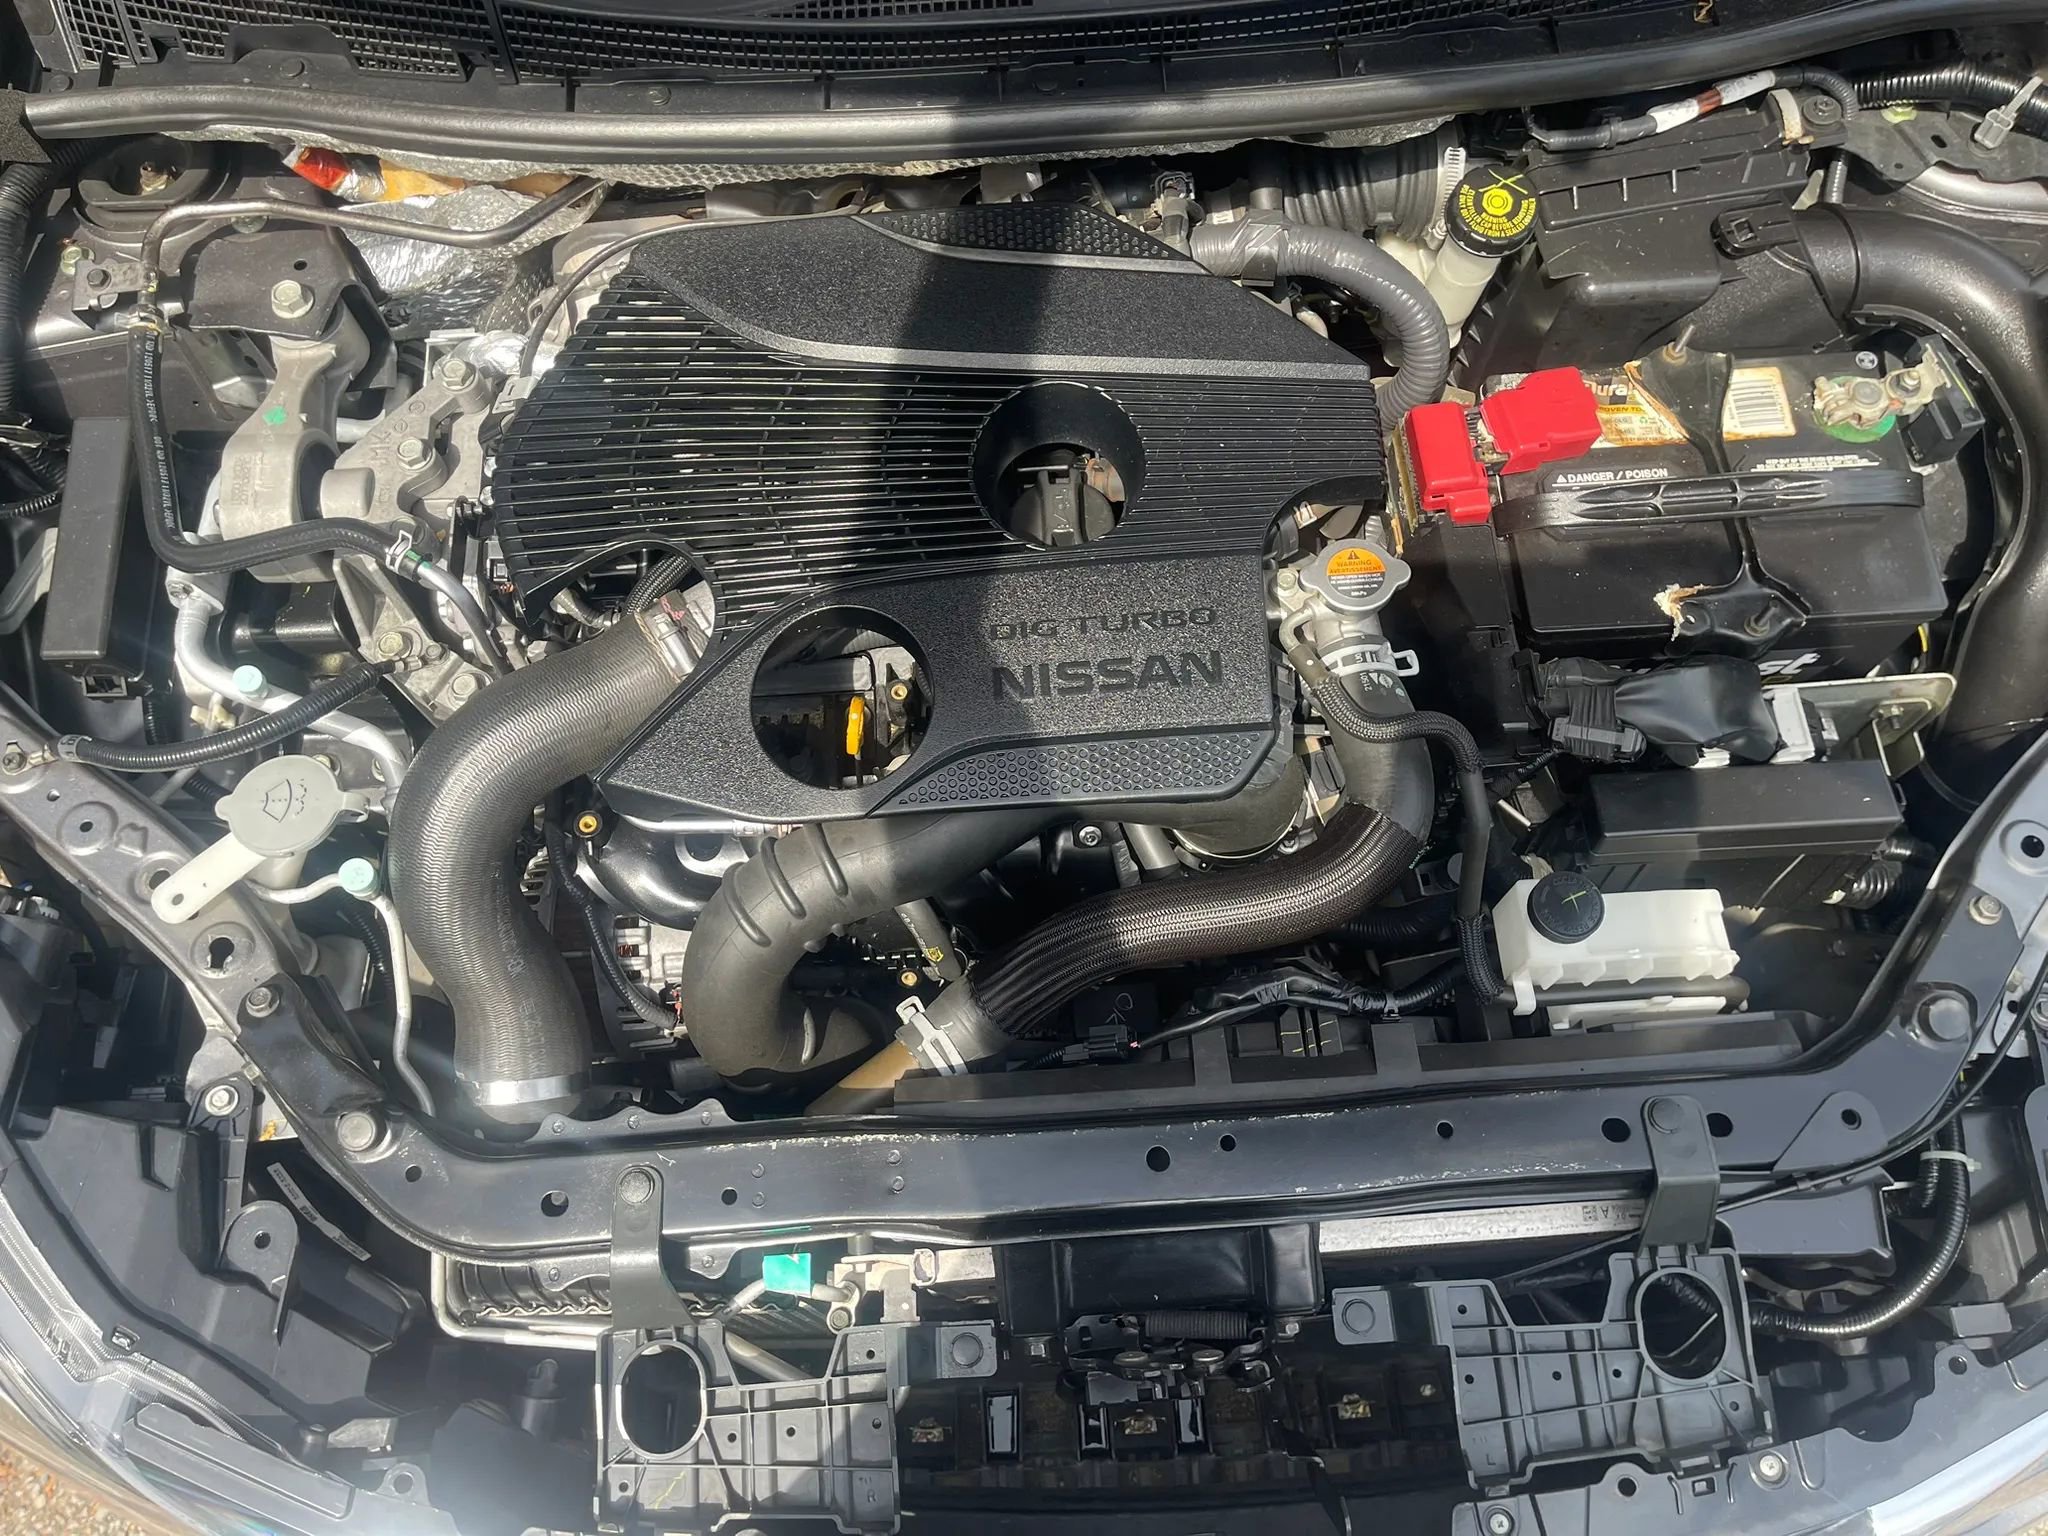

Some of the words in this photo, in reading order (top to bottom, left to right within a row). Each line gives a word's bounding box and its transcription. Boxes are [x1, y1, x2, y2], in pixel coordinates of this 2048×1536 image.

[1568, 472, 1614, 483] DANGER
[1616, 471, 1622, 480] /
[1625, 468, 1668, 479] POISON
[990, 620, 1058, 640] DIG
[1069, 608, 1217, 634] TURBO
[991, 650, 1223, 700] NISSAN
